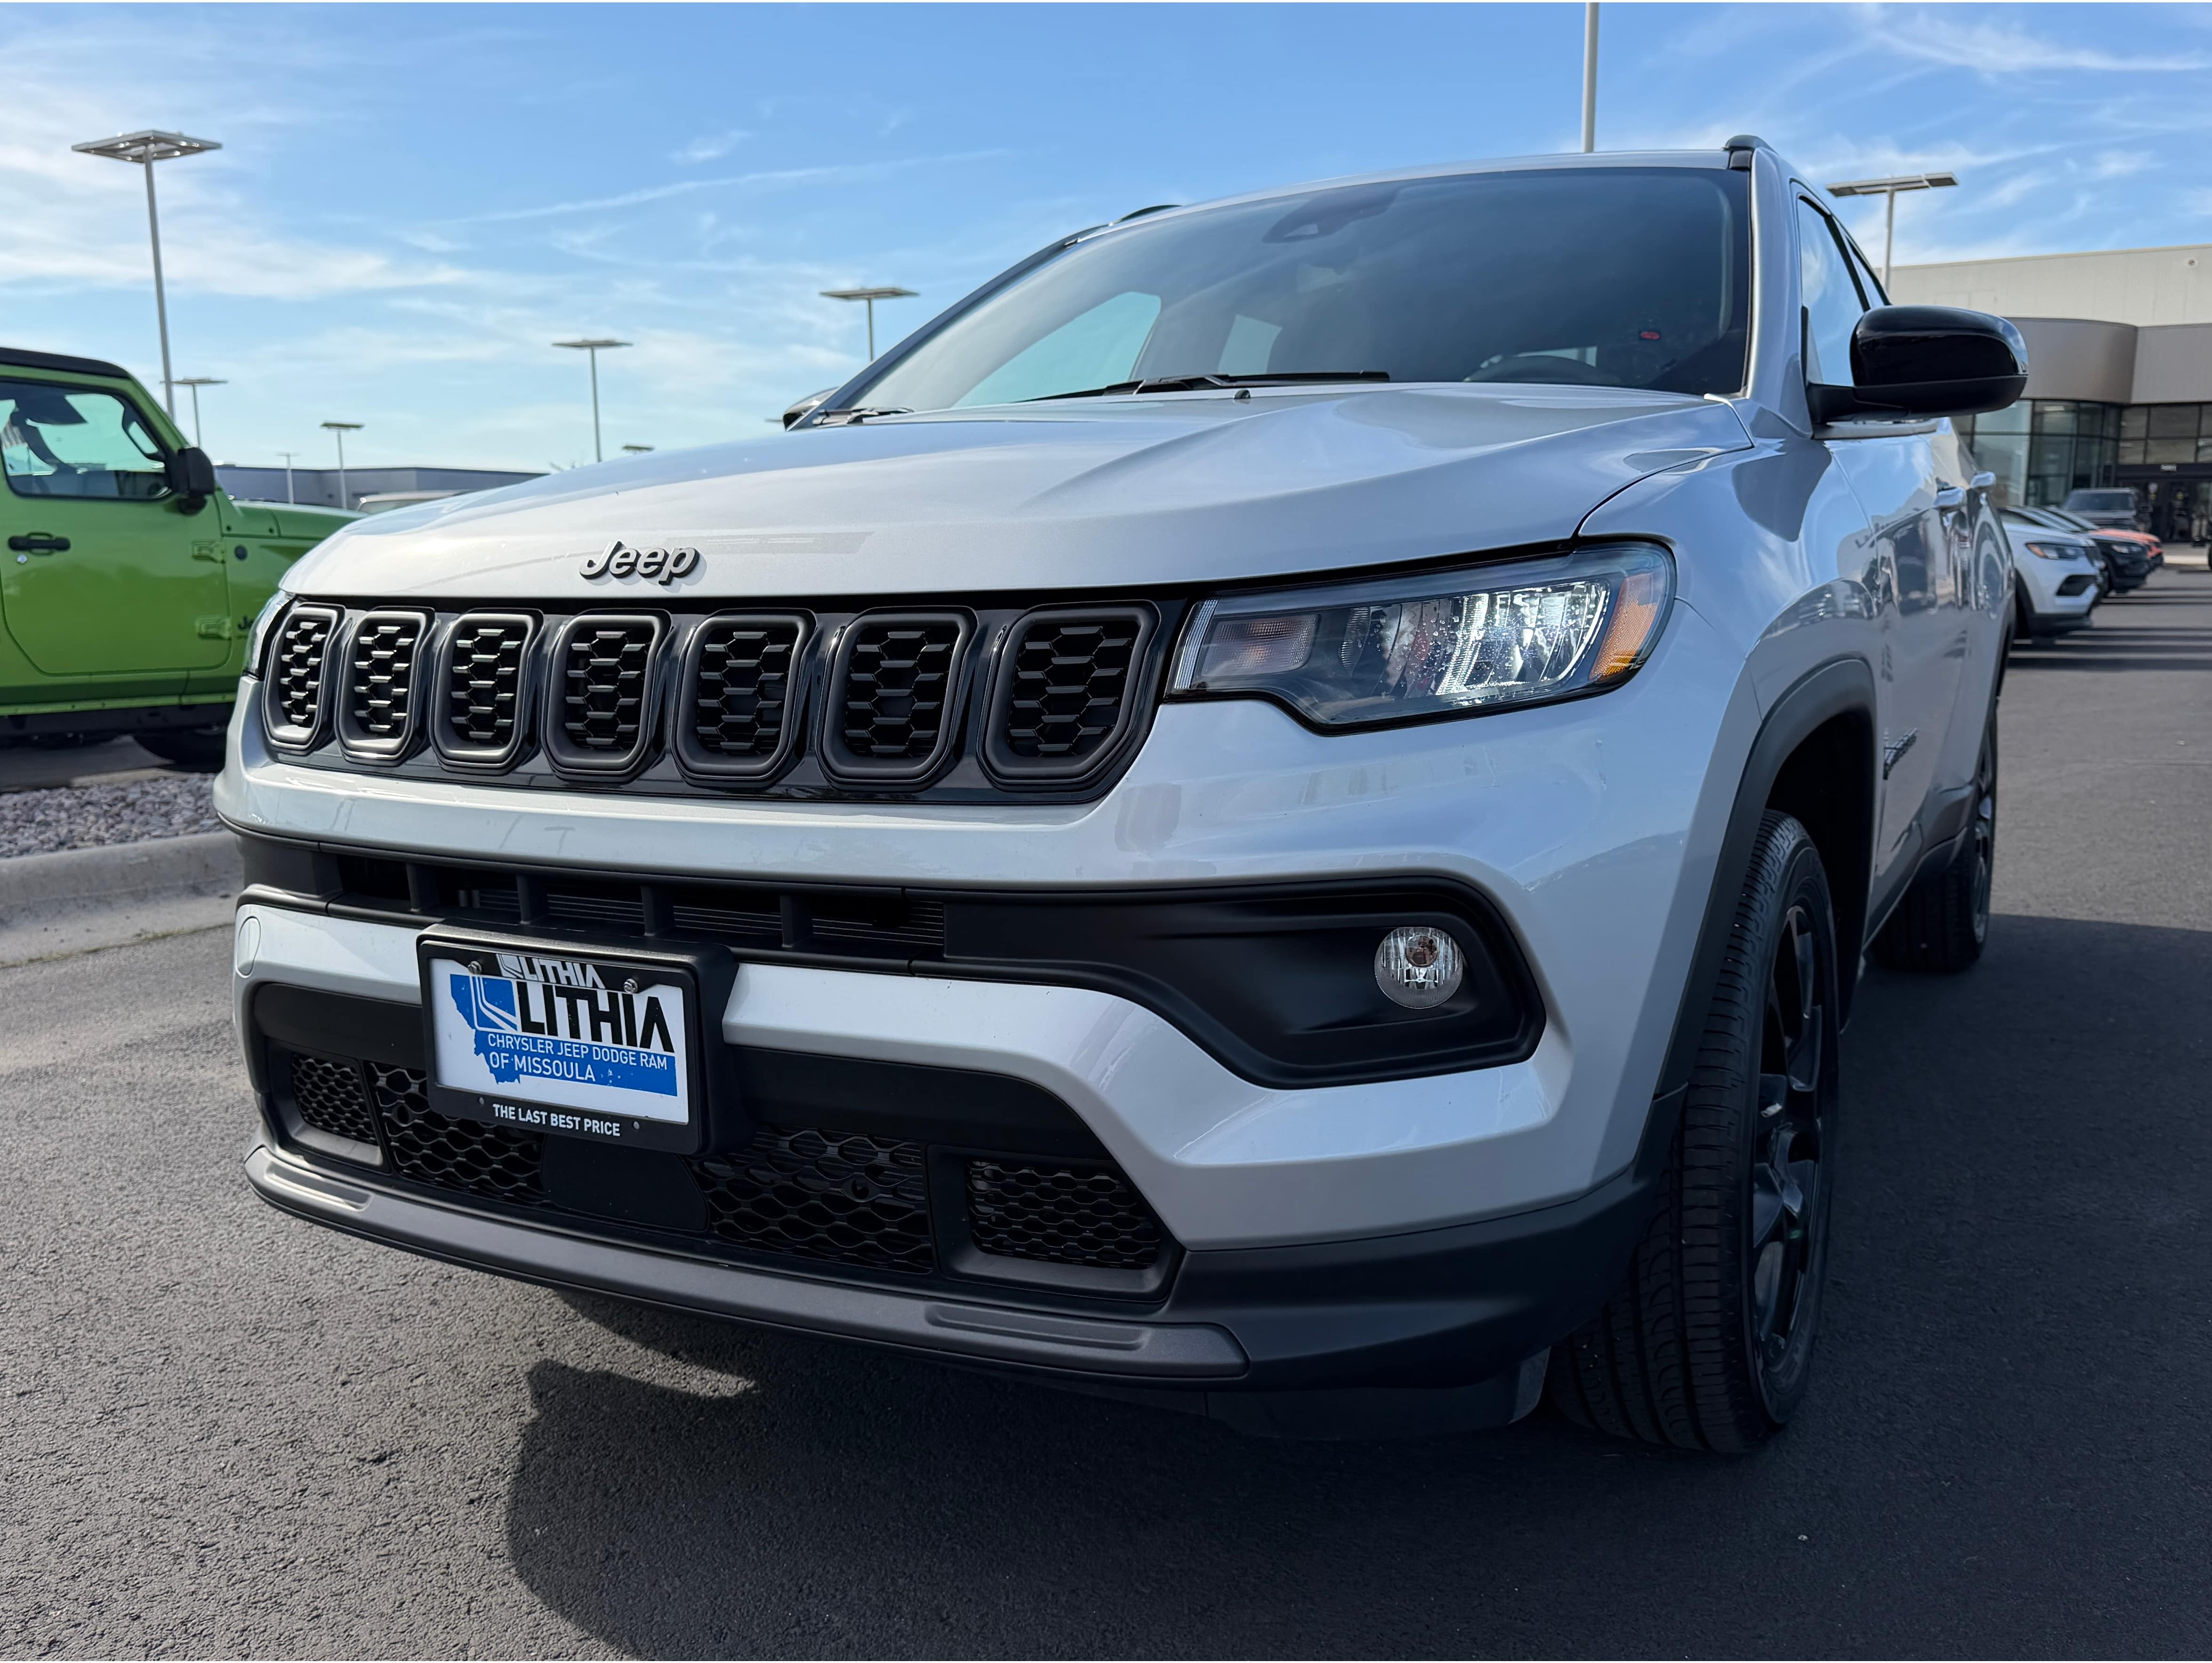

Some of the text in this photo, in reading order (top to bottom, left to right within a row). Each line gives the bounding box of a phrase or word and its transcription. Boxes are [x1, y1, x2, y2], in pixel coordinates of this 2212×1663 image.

[579, 541, 700, 586] Jeep
[518, 956, 606, 989] LITHIA
[516, 980, 675, 1053] LITHIA
[488, 1033, 667, 1071] CHRYSLER JEEP DODGE RAM
[489, 1051, 596, 1082] OF MISSOULA
[493, 1104, 621, 1137] THE LAST BEST PRICE
